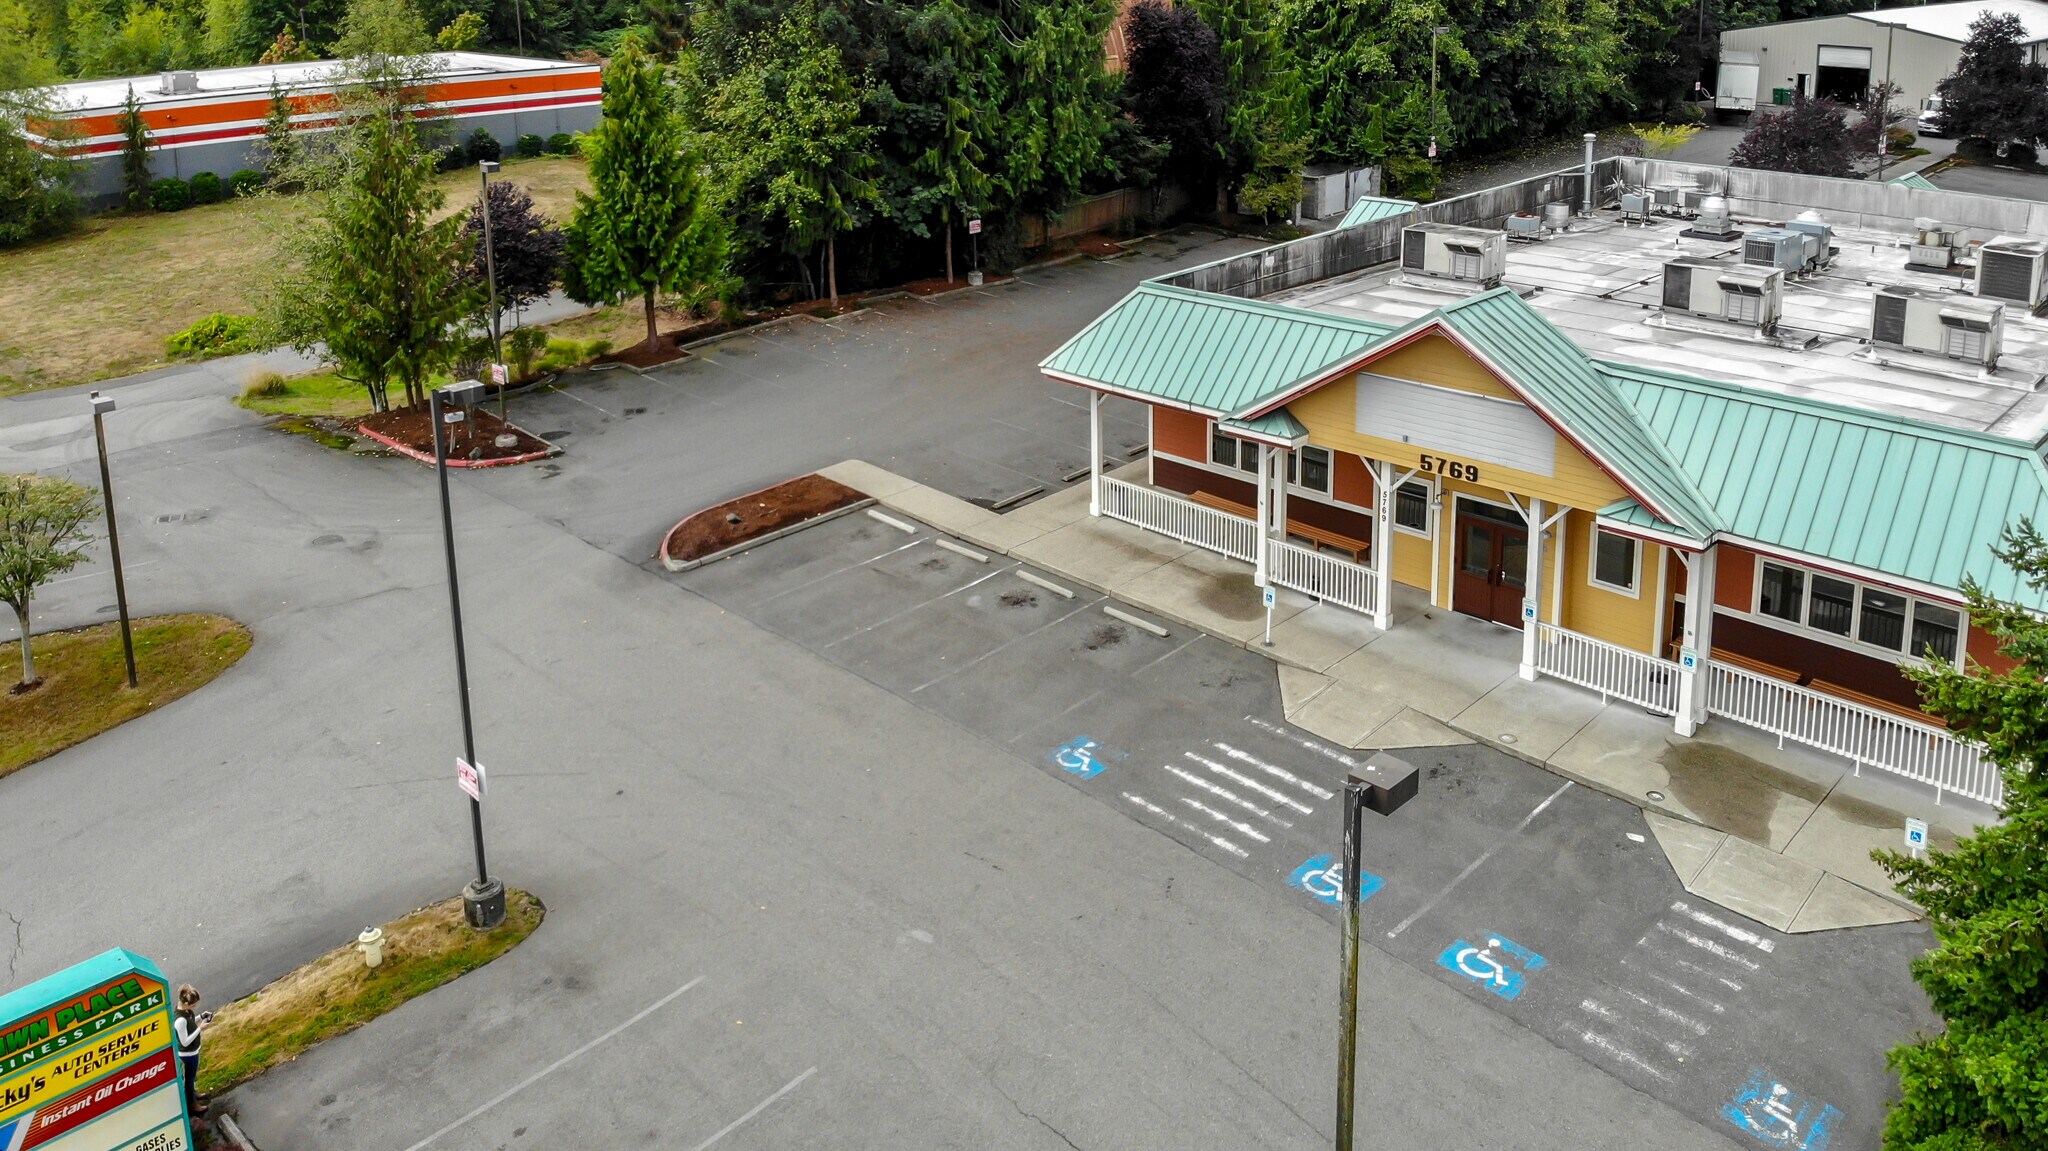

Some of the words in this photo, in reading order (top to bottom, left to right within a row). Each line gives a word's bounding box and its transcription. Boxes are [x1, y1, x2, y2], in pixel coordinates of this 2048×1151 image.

[1420, 454, 1479, 482] 5769
[55, 977, 145, 1032] PLACE
[95, 995, 160, 1030] PARK
[52, 1050, 94, 1078] AUTO
[98, 1020, 160, 1057] SERVICE
[74, 1041, 140, 1079] CENTERS
[41, 1095, 93, 1128] Instant
[95, 1084, 113, 1102] Oil
[115, 1061, 167, 1093] Change
